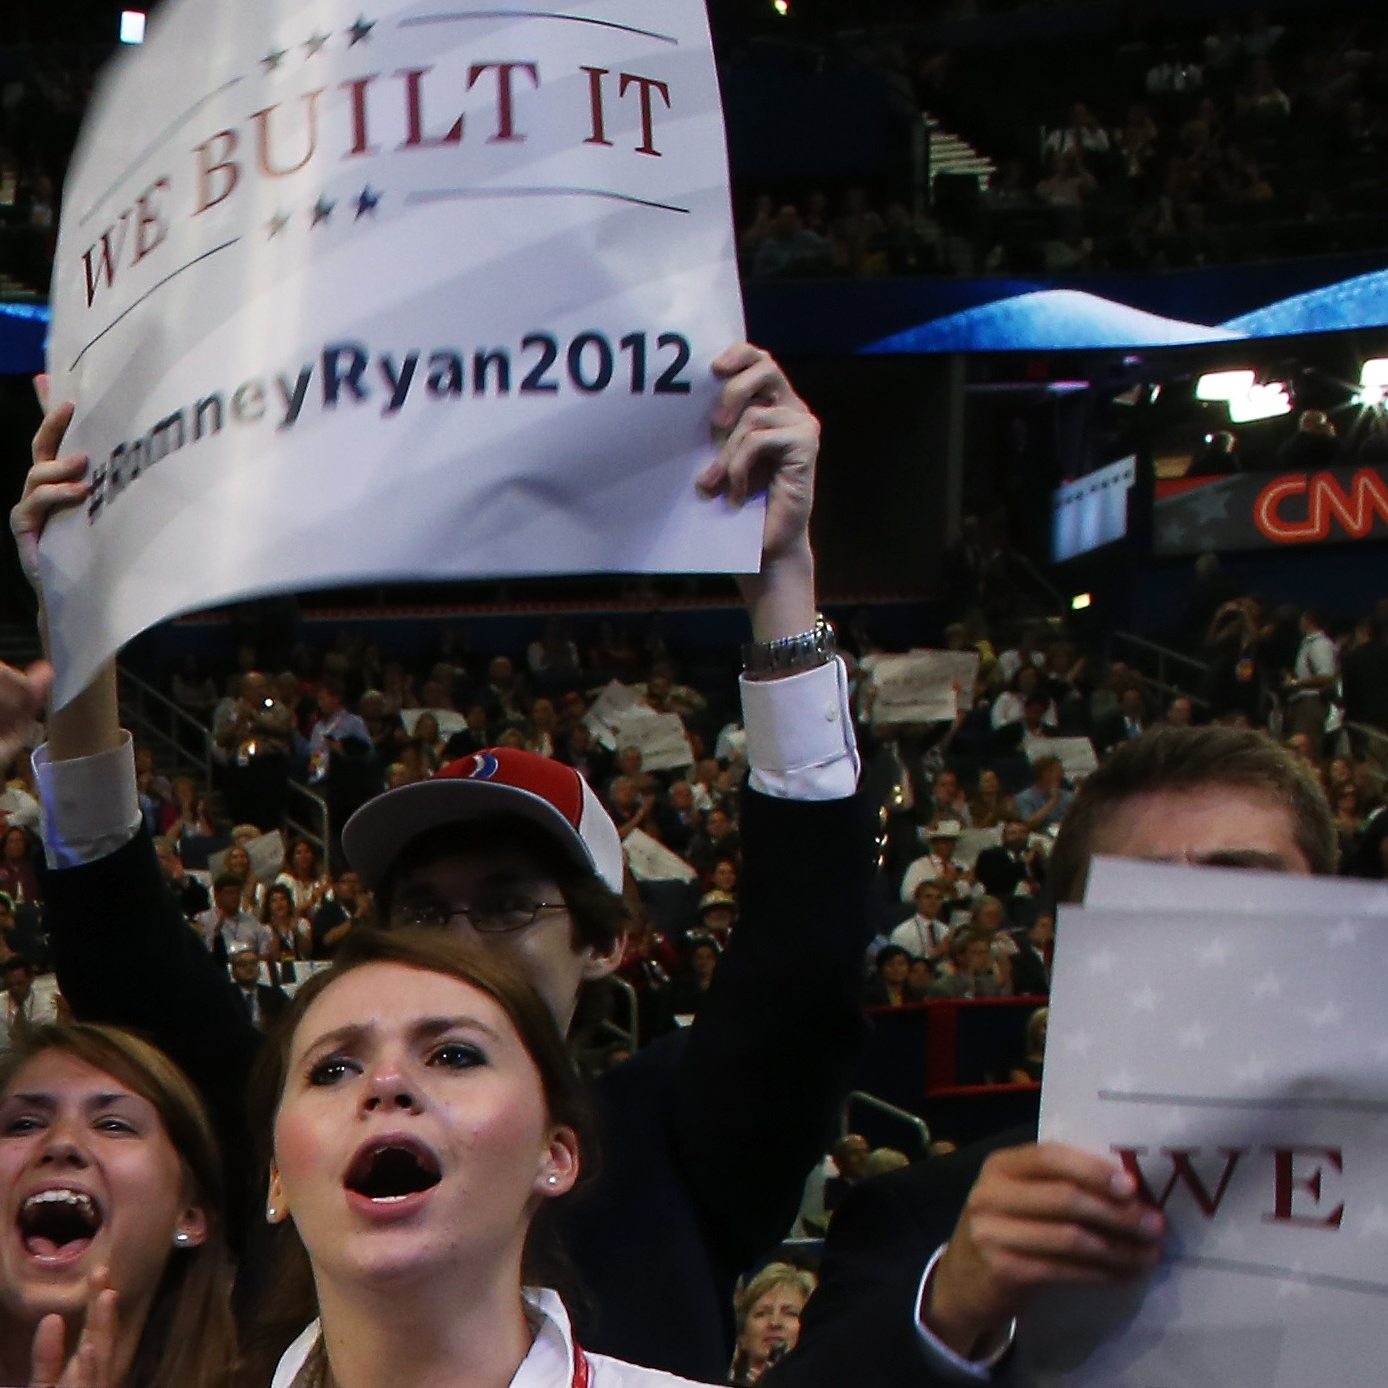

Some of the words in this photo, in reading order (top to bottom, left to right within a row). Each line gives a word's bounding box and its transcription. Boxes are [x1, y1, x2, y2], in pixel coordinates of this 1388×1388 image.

[79, 176, 173, 309] WE
[190, 62, 540, 218] BUILT
[578, 66, 671, 158] IT
[85, 332, 693, 527] #RomneyRyan2012
[1110, 1144, 1344, 1232] WE
